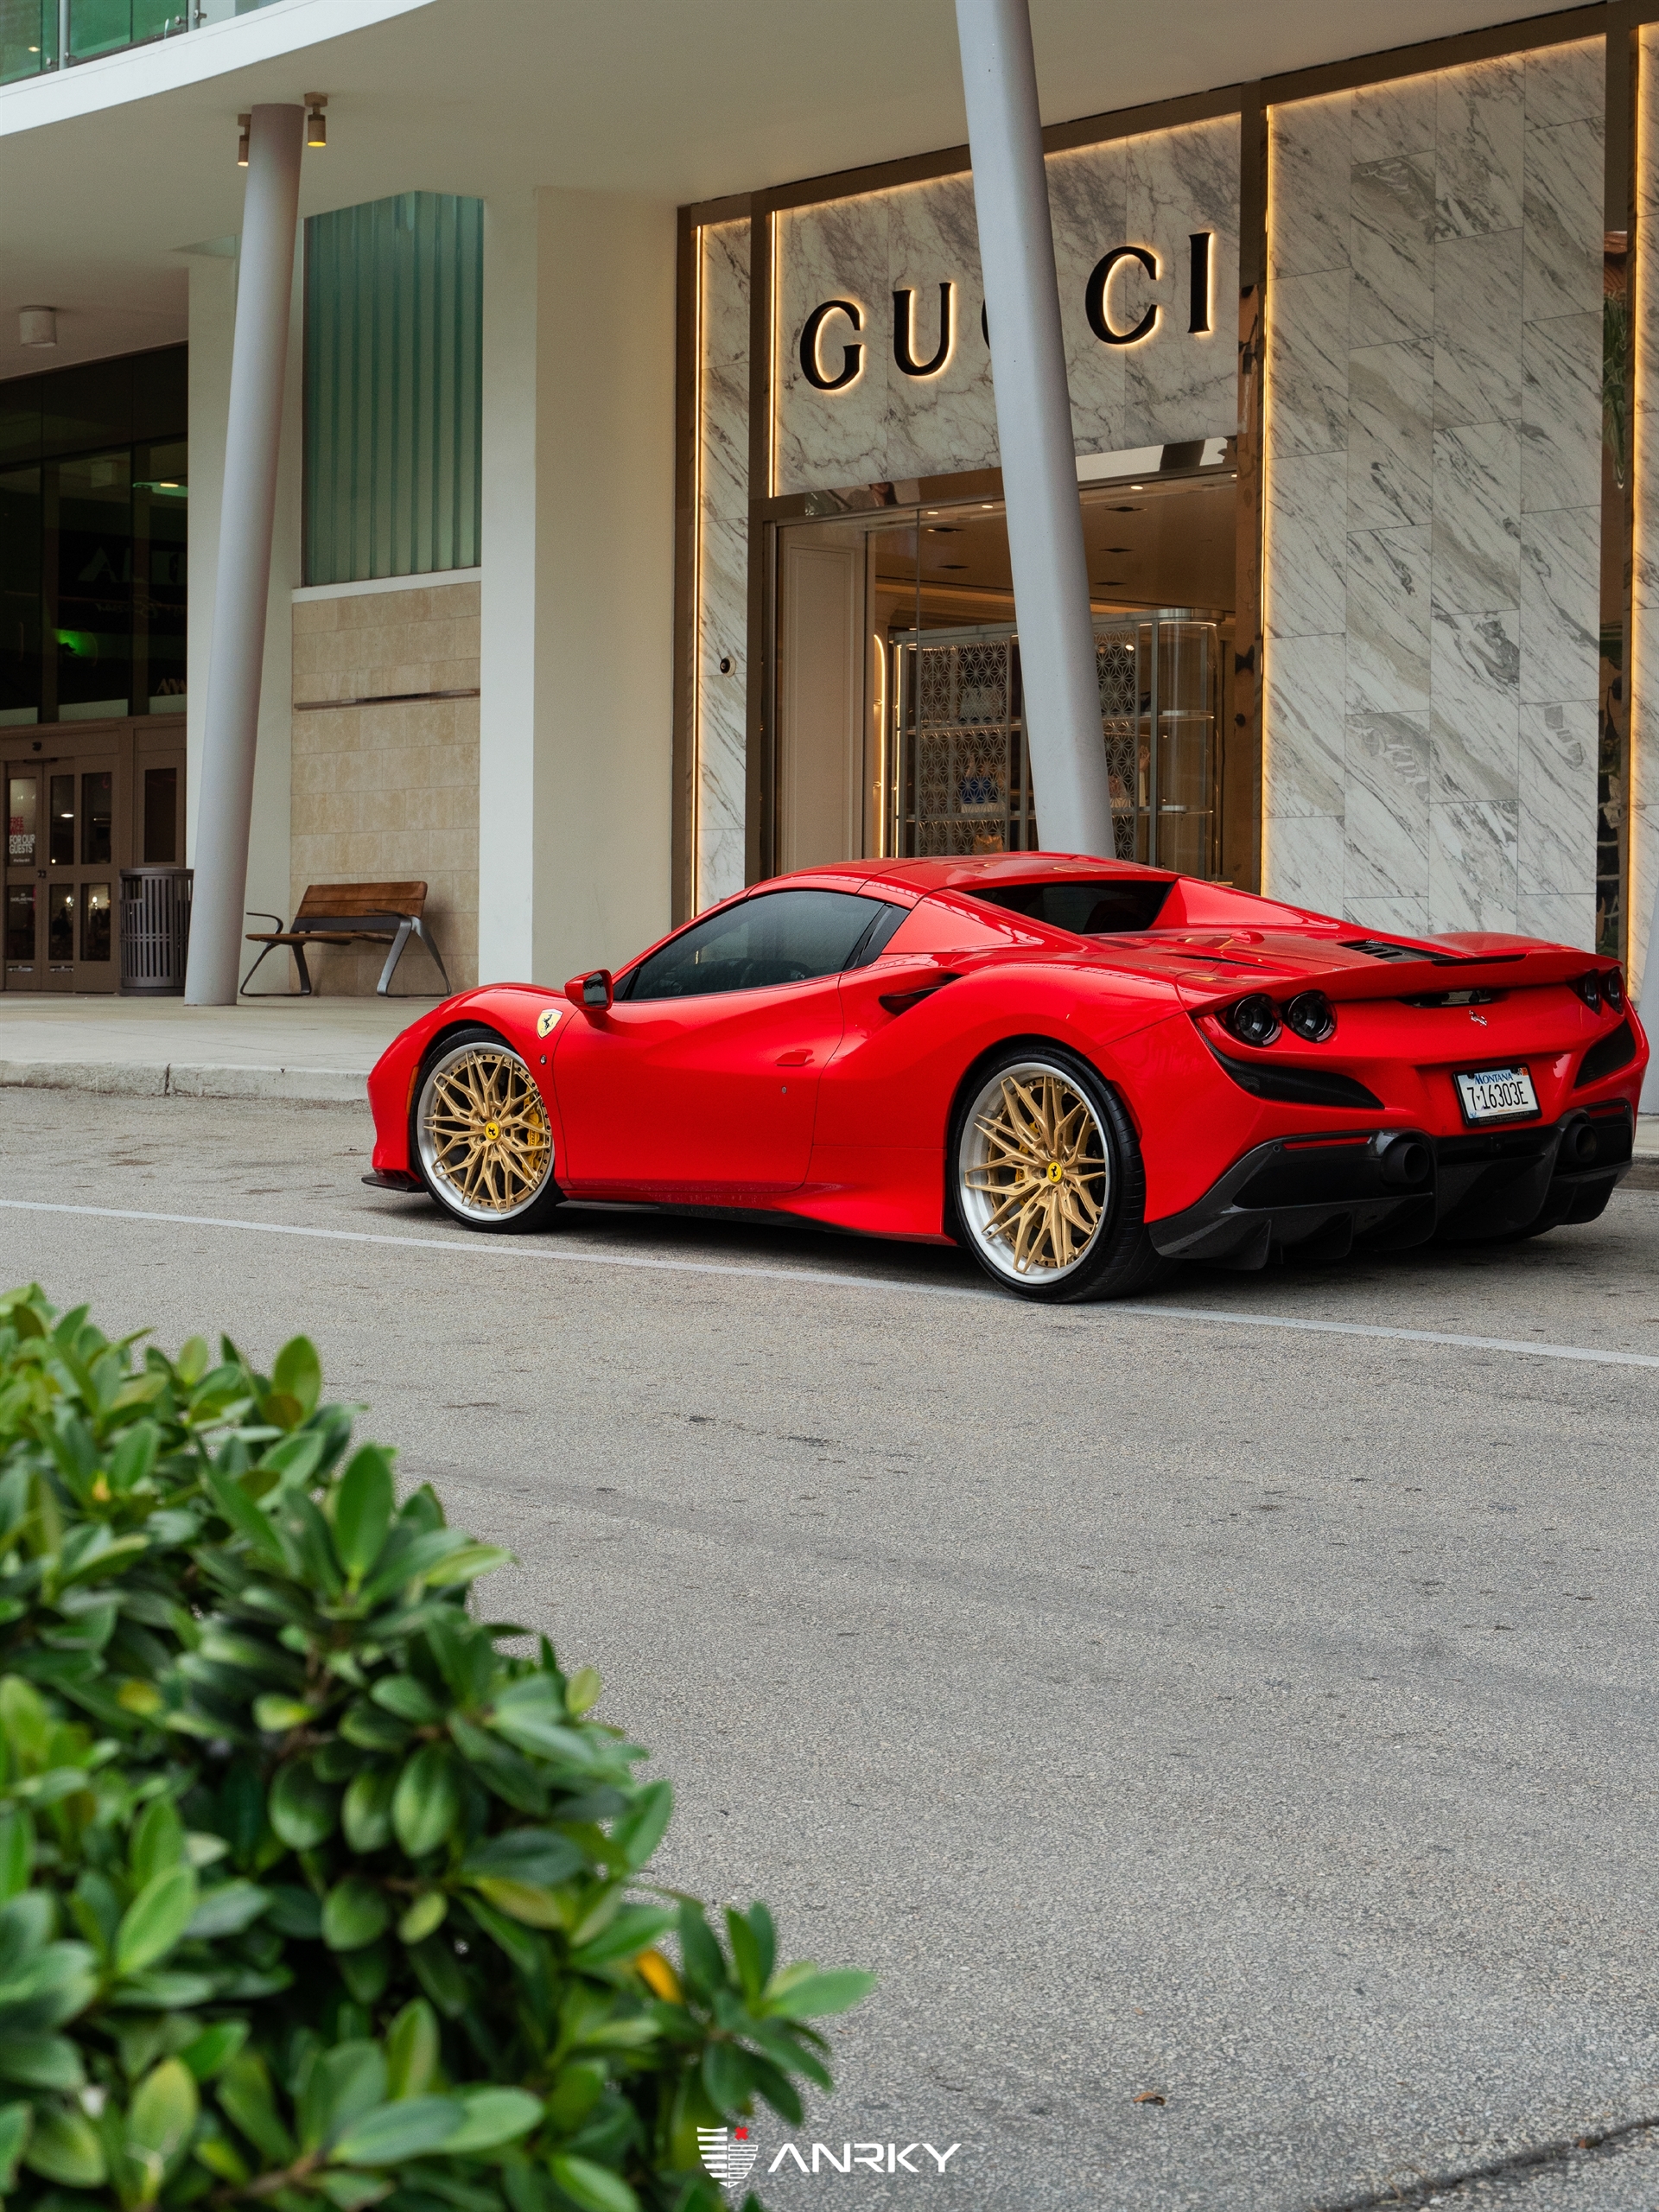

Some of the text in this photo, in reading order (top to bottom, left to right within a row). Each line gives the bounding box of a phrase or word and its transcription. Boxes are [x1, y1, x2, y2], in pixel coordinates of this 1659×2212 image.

[799, 232, 1212, 390] GUCI
[9, 834, 35, 845] FOR OUR
[9, 844, 33, 854] GUESTS
